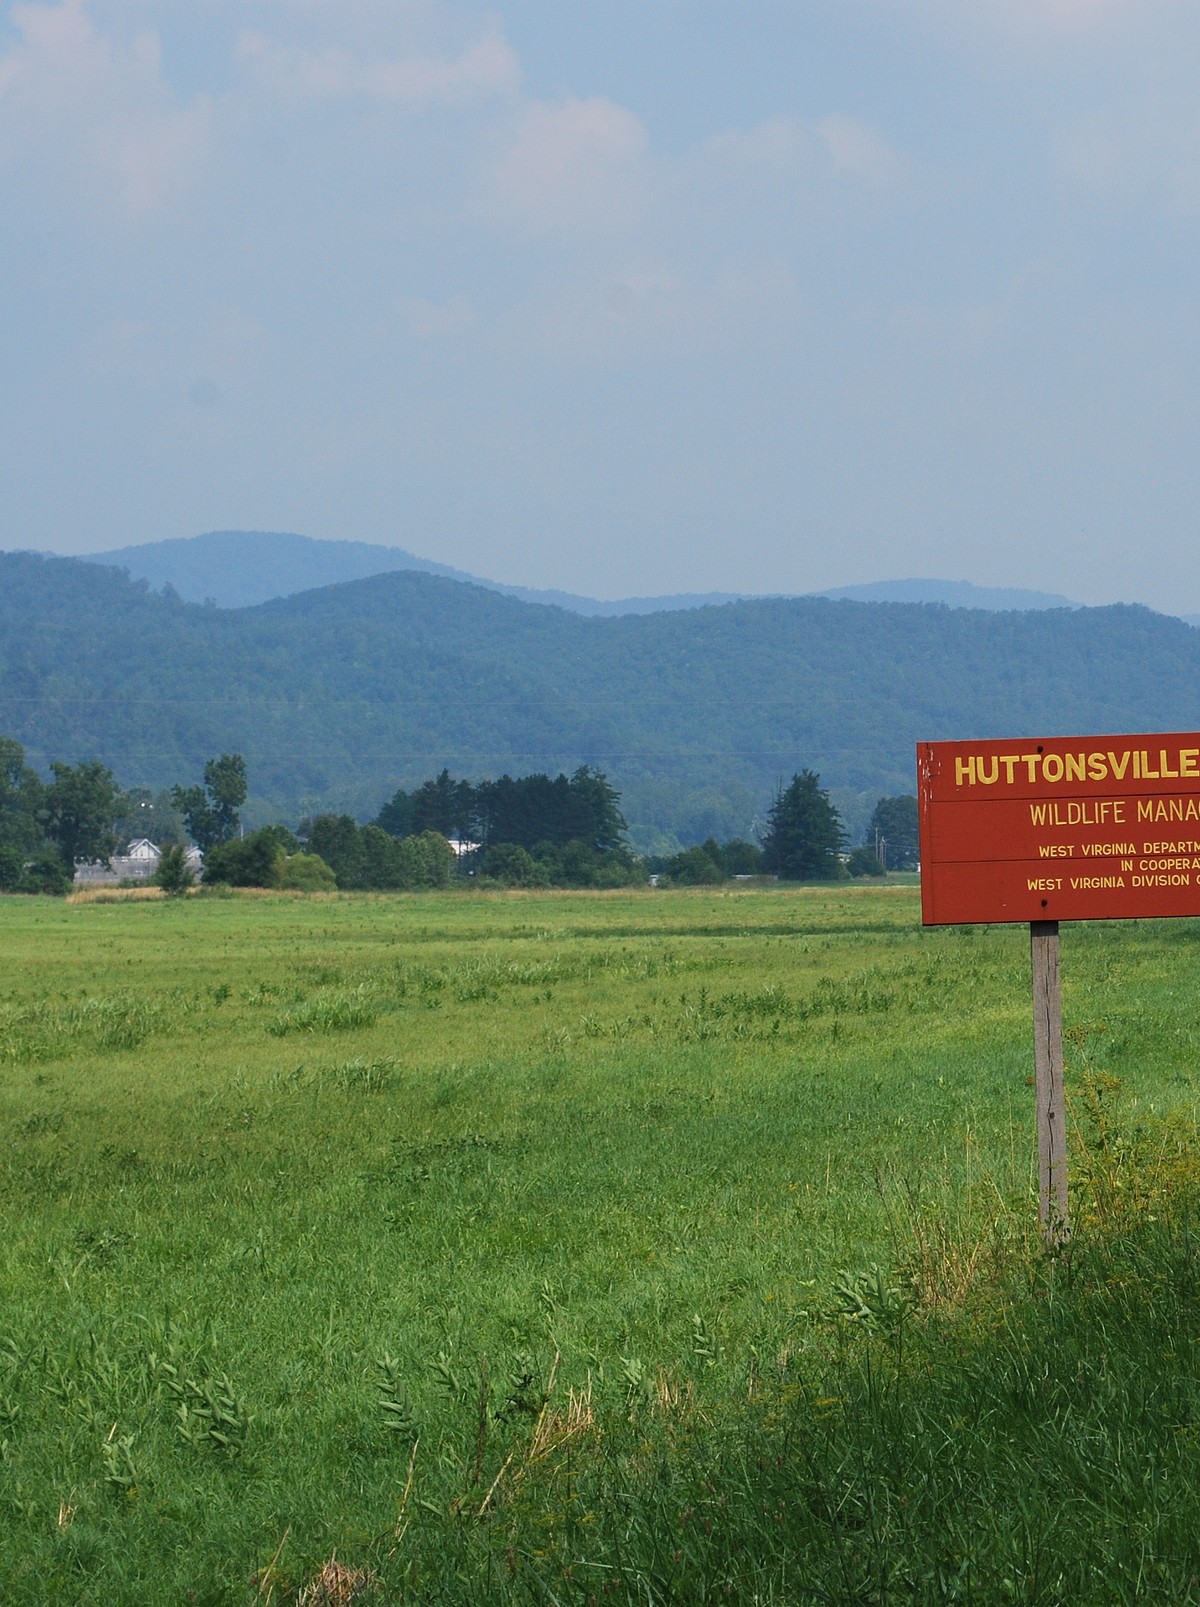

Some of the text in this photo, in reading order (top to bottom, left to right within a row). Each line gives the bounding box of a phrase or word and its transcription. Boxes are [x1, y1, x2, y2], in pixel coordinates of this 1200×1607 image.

[954, 748, 1200, 786] HUTTONSVILLE
[1029, 801, 1126, 826] WILDLIFE
[1038, 845, 1075, 858] WEST
[1081, 842, 1137, 856] VIRGINIA
[1120, 859, 1134, 872] IN
[1027, 878, 1063, 891] WEST
[1069, 875, 1126, 890] VIRGINIA
[1131, 873, 1190, 887] DIVISION
